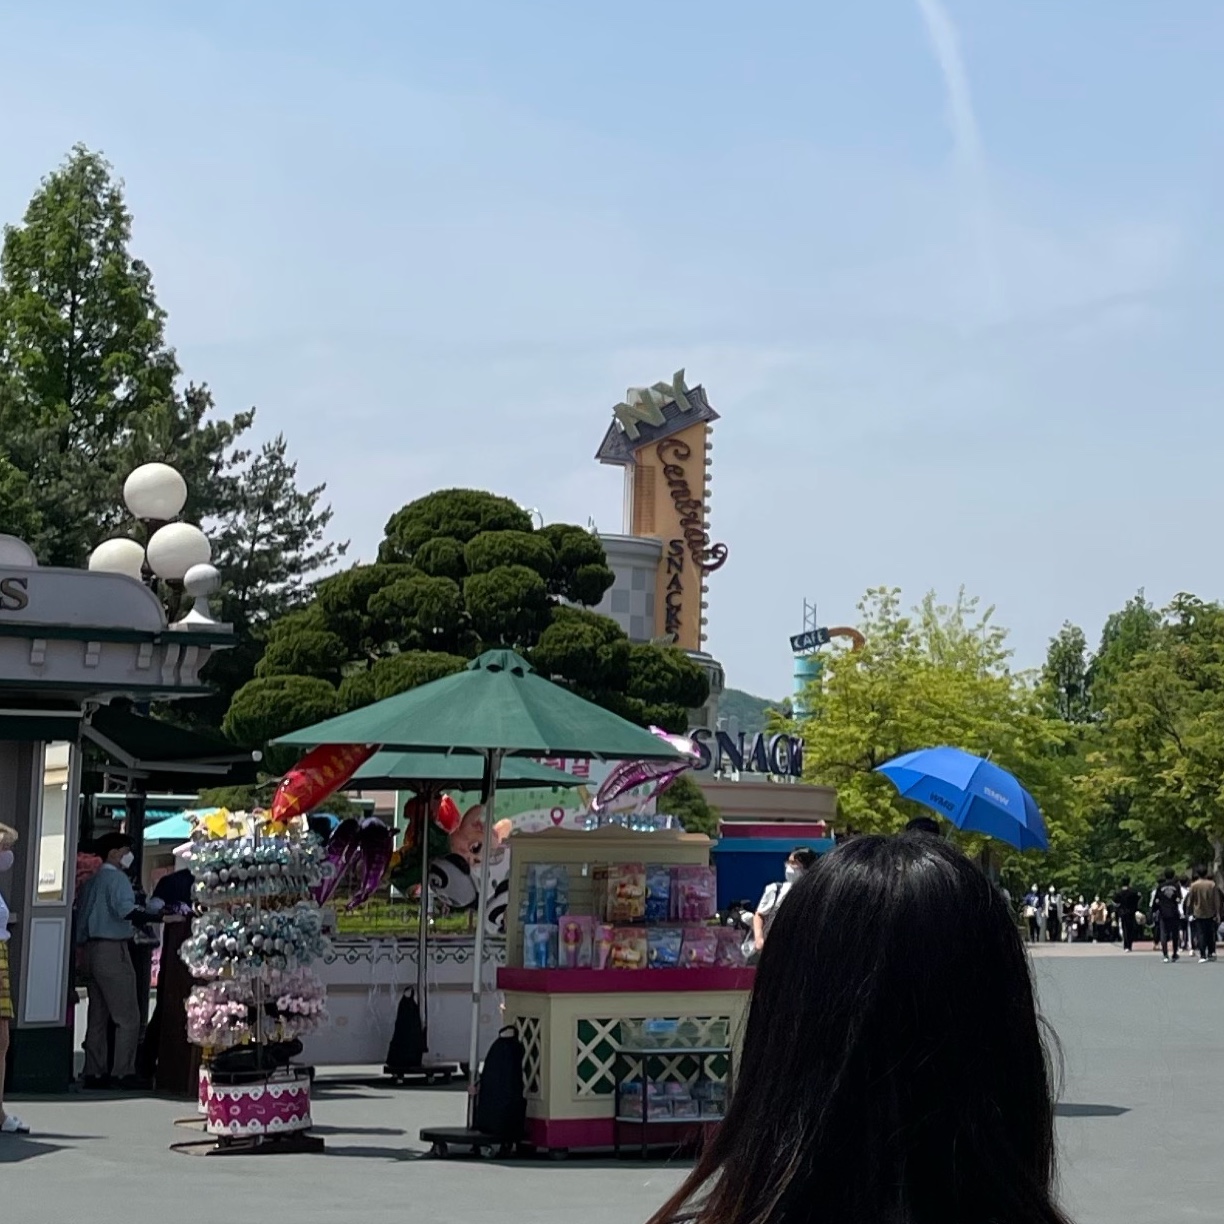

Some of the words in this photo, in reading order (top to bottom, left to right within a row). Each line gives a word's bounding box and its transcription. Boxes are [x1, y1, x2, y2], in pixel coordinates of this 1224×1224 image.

[612, 368, 693, 441] NY
[656, 438, 728, 571] Central
[0, 577, 29, 611] S
[665, 539, 684, 643] SNACKS
[793, 631, 825, 649] CAFE
[984, 786, 1009, 806] BMW
